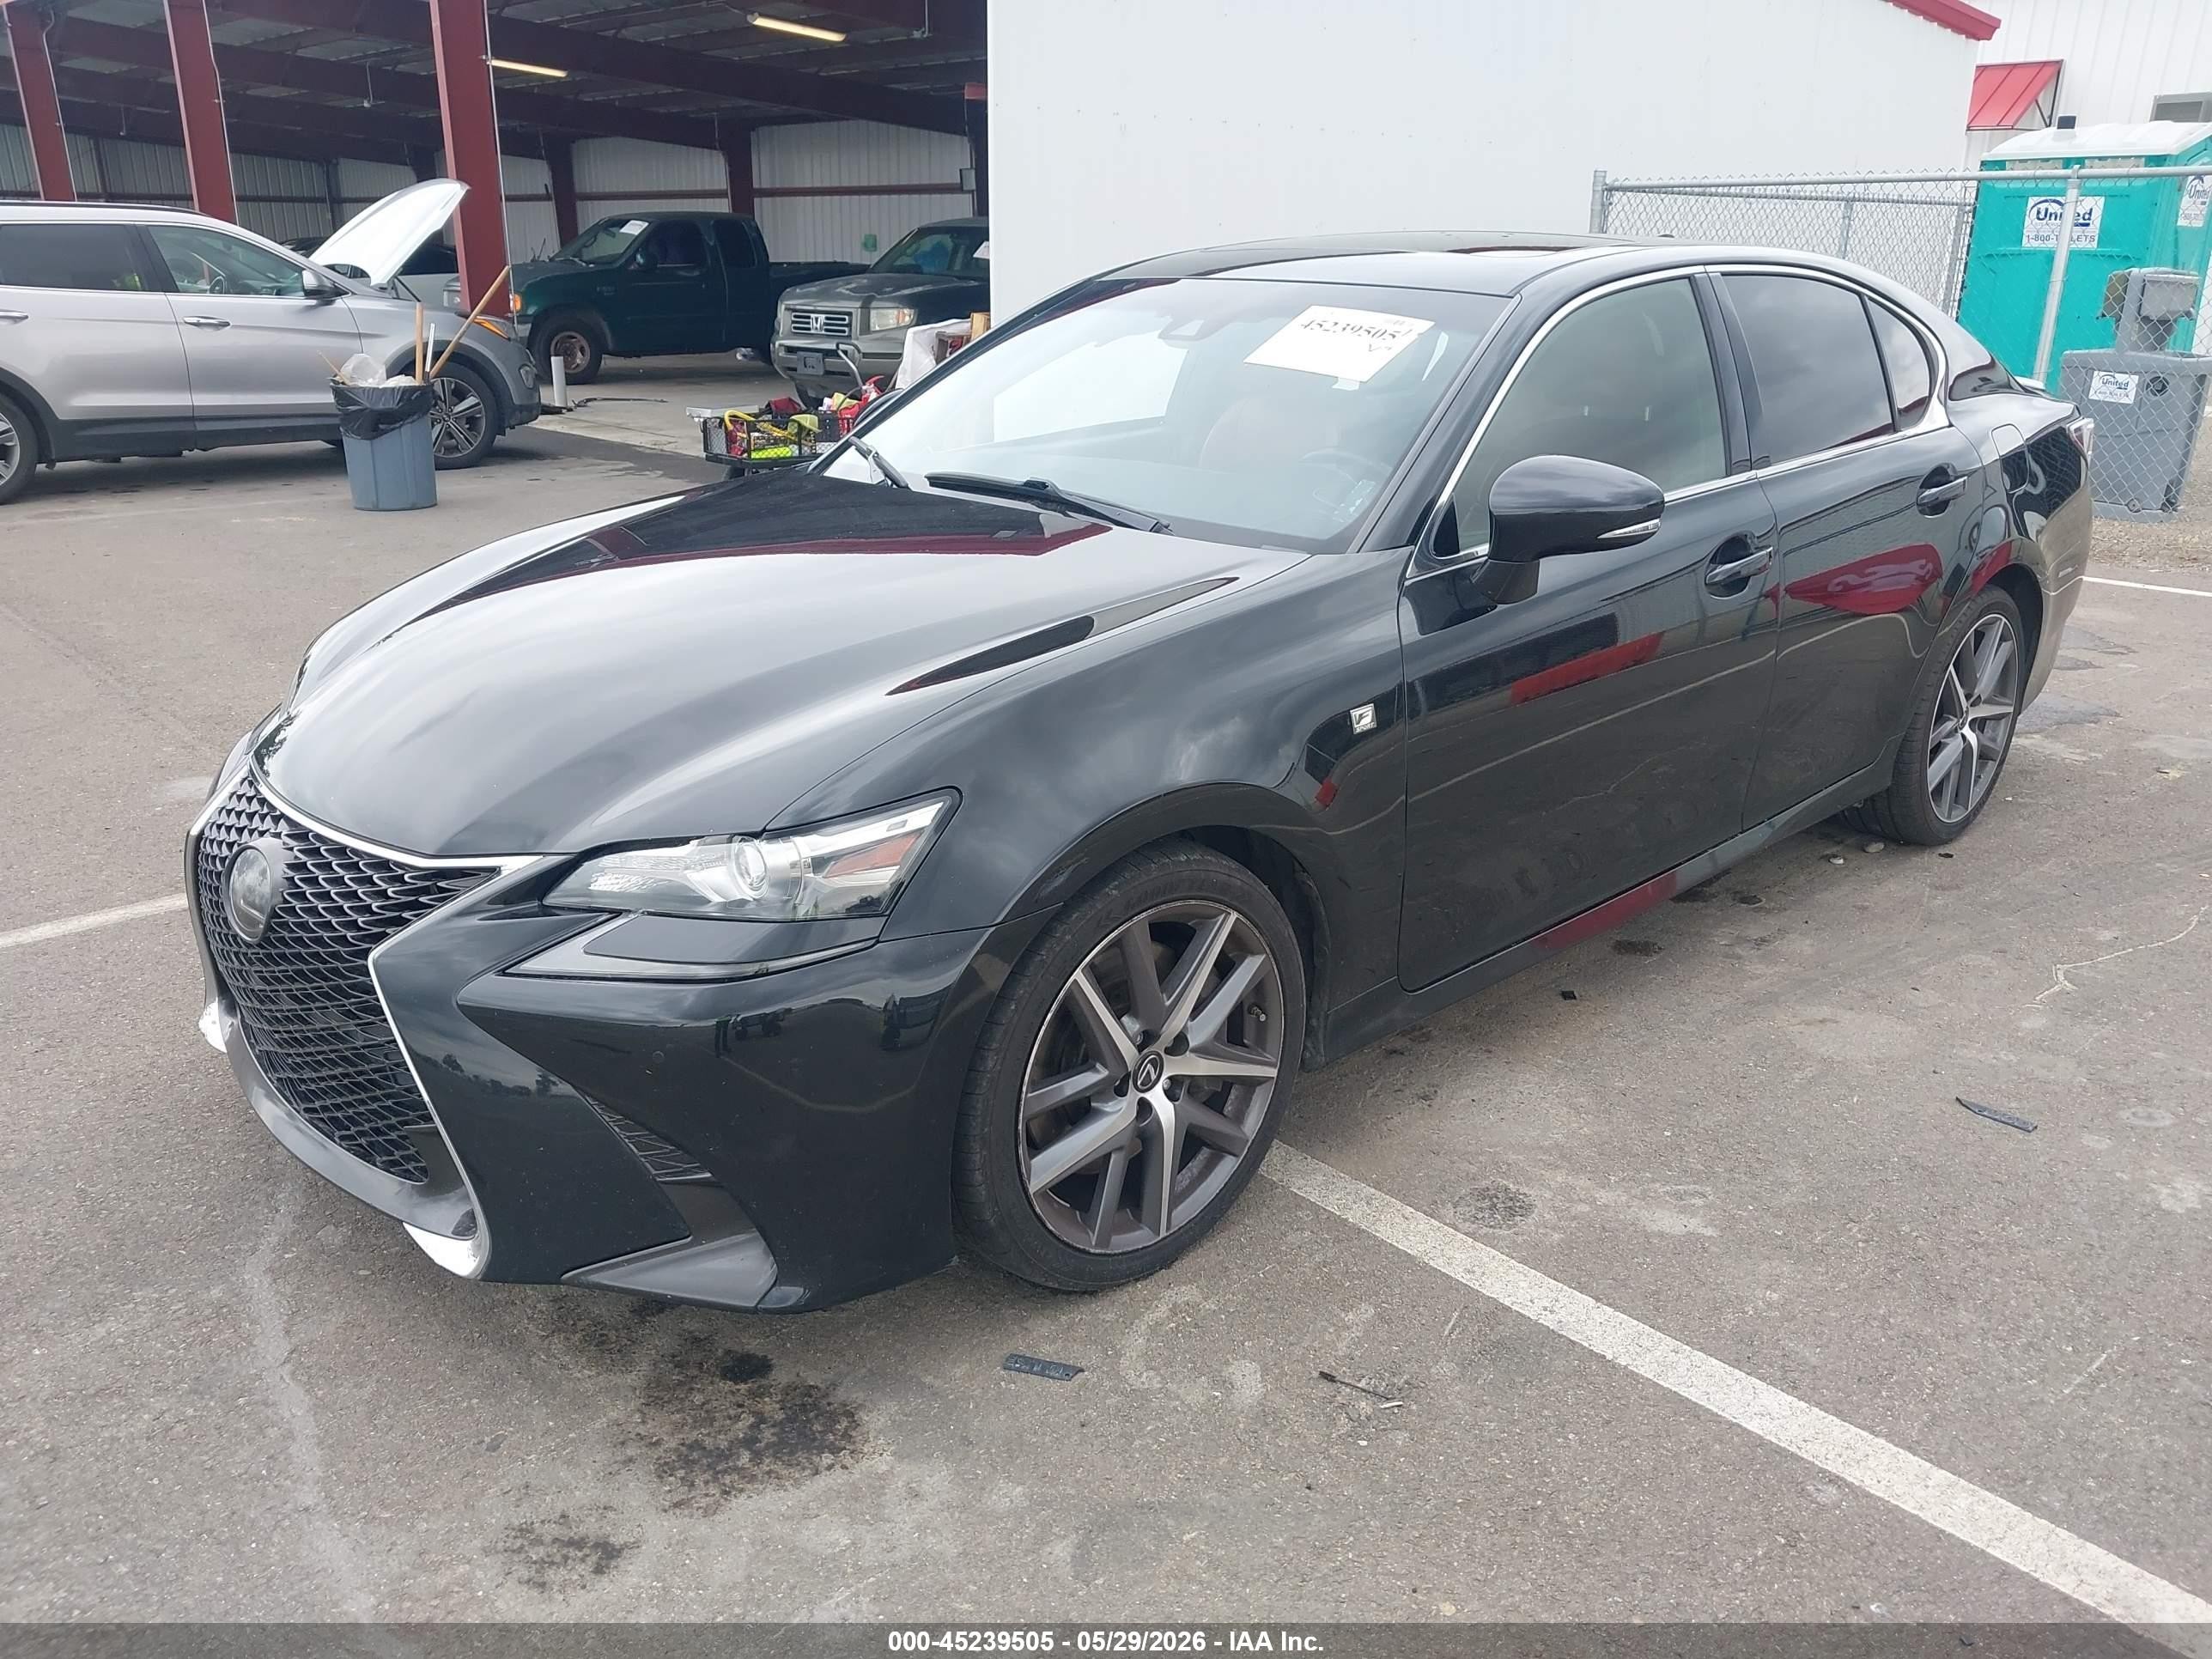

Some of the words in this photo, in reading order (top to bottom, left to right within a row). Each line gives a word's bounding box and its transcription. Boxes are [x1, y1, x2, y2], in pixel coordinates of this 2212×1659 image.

[2036, 207, 2093, 221] Unied
[2026, 234, 2095, 242] 1-800-TLETS
[1301, 319, 1401, 341] 45239505
[2102, 378, 2130, 387] United
[1355, 722, 1375, 732] SPORT
